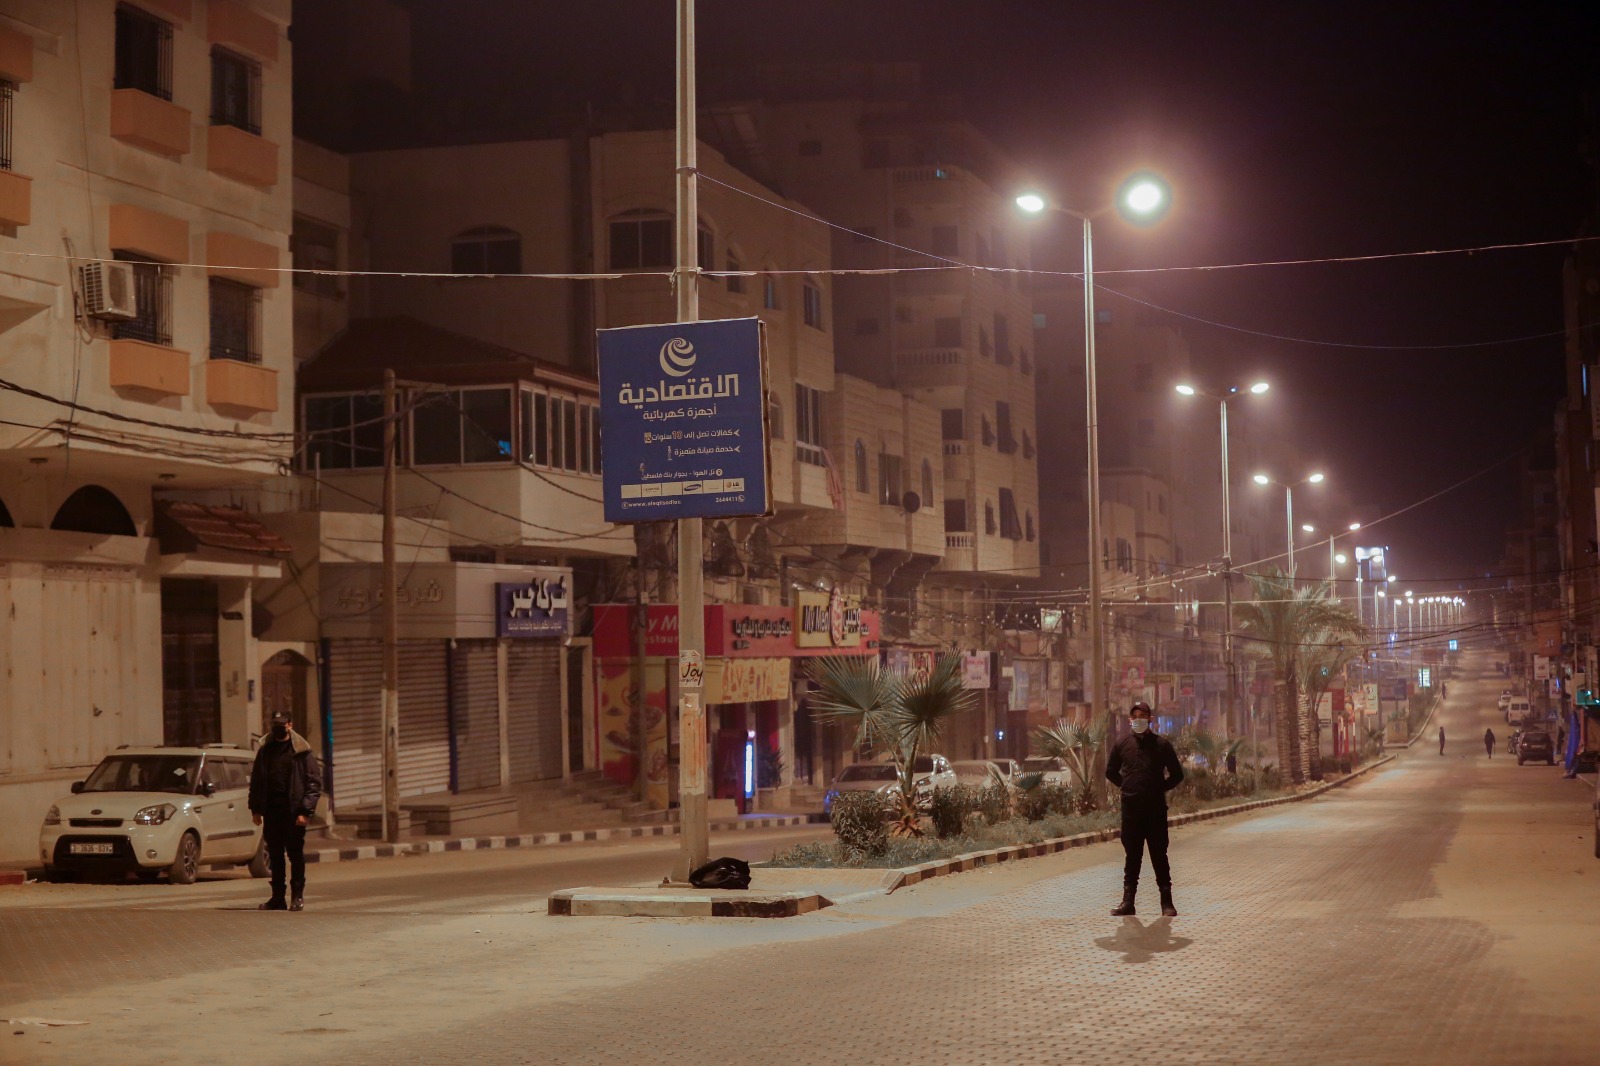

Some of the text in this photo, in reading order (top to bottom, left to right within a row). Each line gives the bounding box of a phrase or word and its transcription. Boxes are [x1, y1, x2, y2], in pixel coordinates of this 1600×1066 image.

[619, 374, 739, 409] الاقتصادية
[643, 403, 717, 422] أجهزة كهربائية
[696, 431, 709, 440] تصل
[683, 662, 704, 686] Joy
